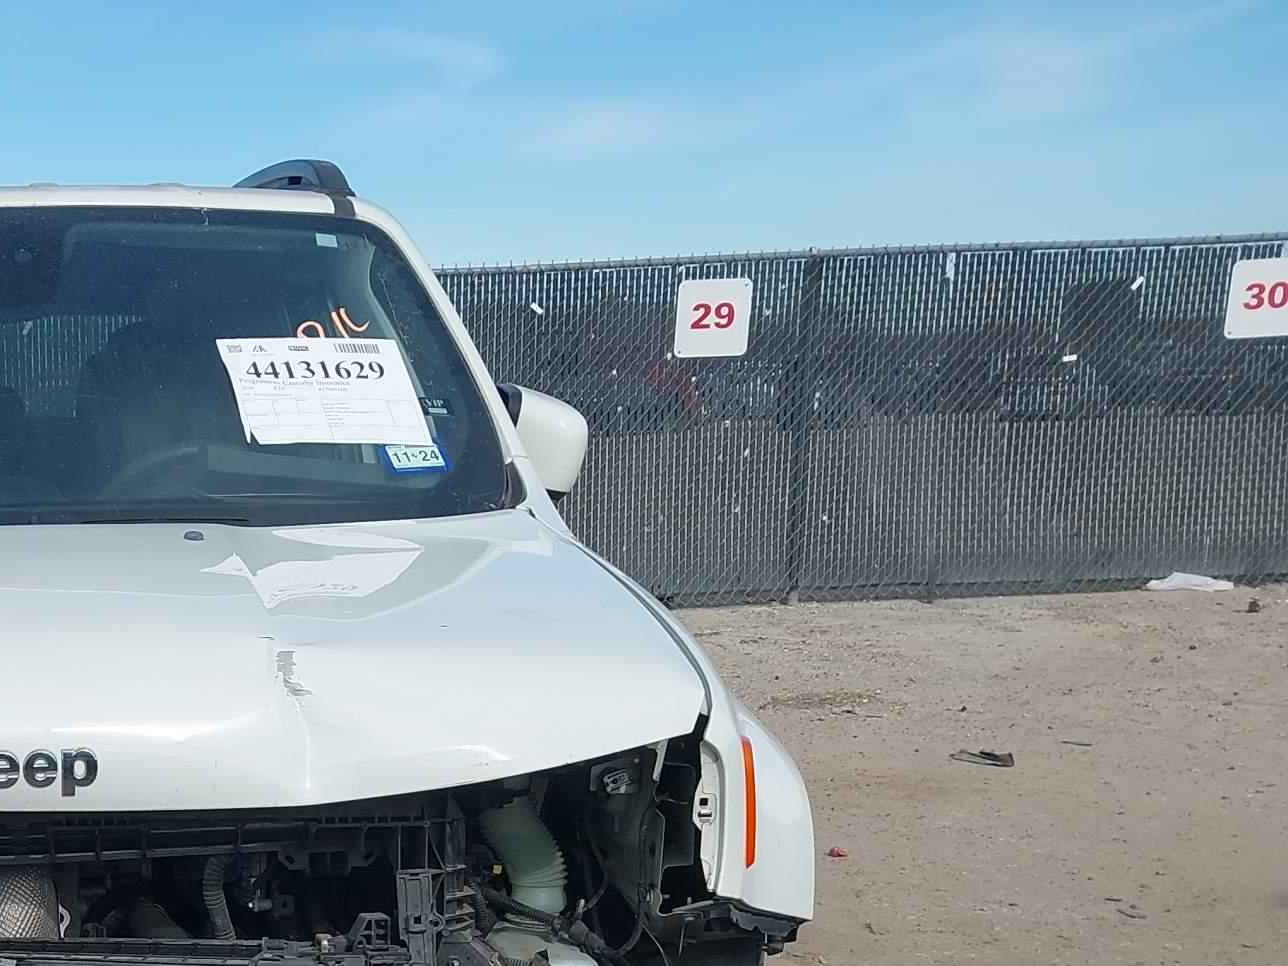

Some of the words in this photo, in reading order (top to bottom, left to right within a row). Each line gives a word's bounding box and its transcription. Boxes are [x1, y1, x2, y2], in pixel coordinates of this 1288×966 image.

[1242, 281, 1288, 310] 30
[690, 302, 735, 329] 29
[246, 360, 385, 379] 44131629
[392, 451, 412, 464] 11
[418, 449, 440, 462] 24
